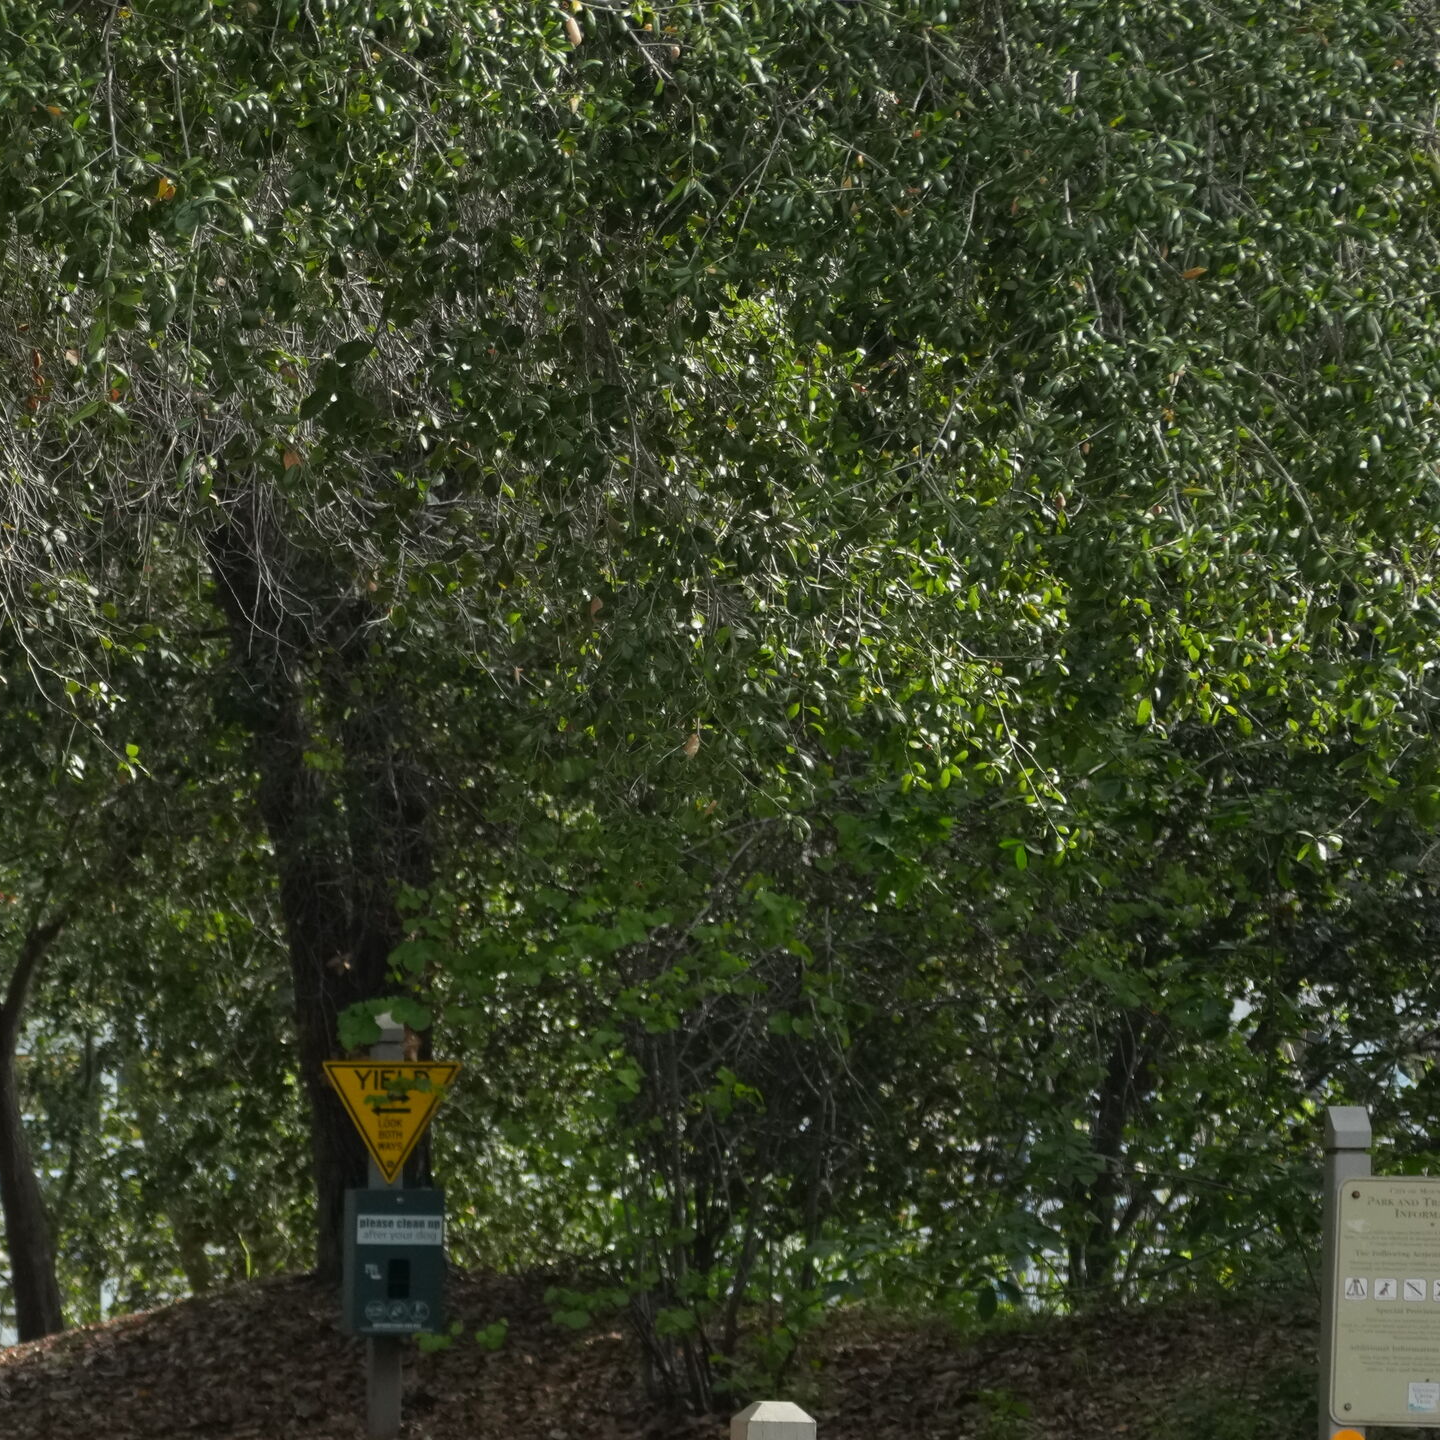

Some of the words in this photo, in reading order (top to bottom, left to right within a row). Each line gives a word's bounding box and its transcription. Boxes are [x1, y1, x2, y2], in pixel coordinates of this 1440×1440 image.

[378, 1130, 403, 1139] BOTH
[378, 1142, 402, 1151] WAYS
[359, 1218, 394, 1229] please
[396, 1218, 425, 1228] clean
[427, 1220, 440, 1230] up
[363, 1230, 387, 1239] after
[390, 1231, 413, 1240] your
[415, 1230, 437, 1241] dog
